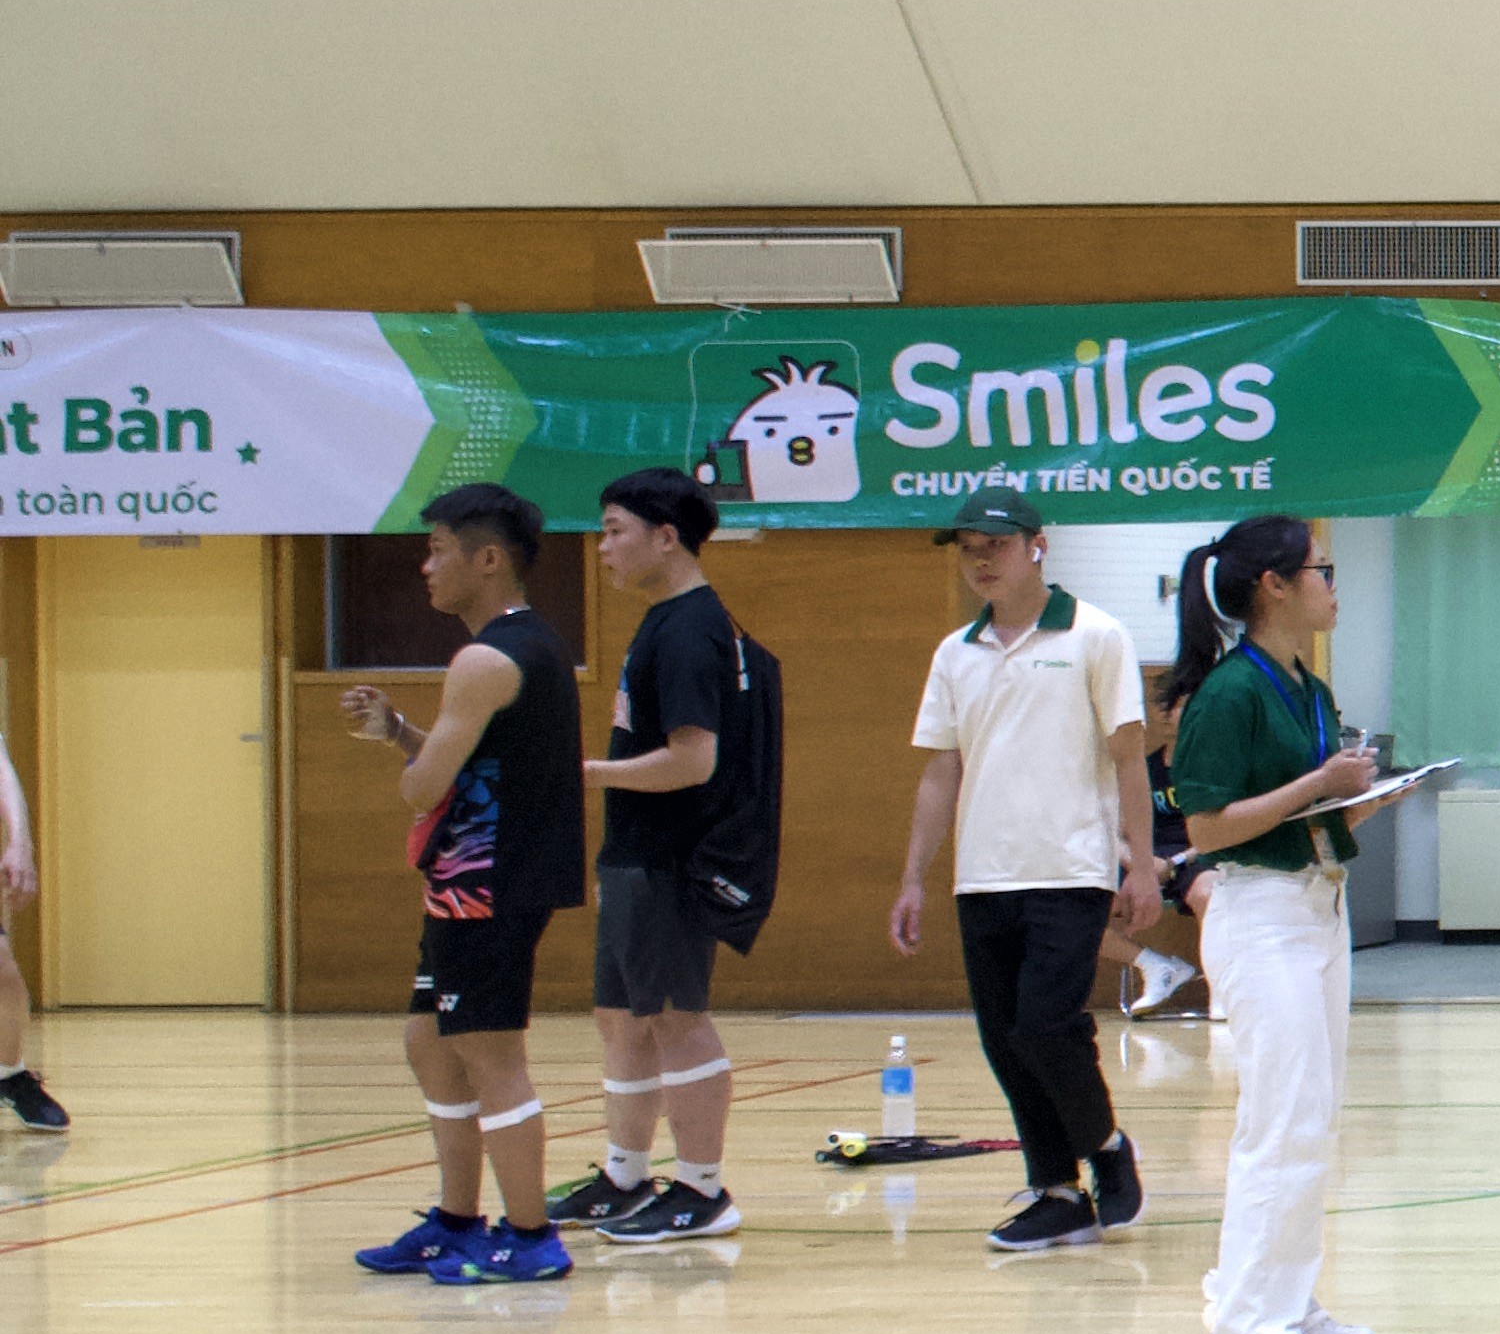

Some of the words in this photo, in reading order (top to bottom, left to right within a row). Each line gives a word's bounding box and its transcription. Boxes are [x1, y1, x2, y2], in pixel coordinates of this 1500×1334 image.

[0, 402, 41, 455] t
[64, 385, 214, 454] Bản
[884, 338, 1277, 449] Smiles
[17, 483, 105, 516] toàn
[117, 480, 219, 522] quốc
[1120, 457, 1223, 496] QUỐC
[1229, 457, 1276, 490] TẾ
